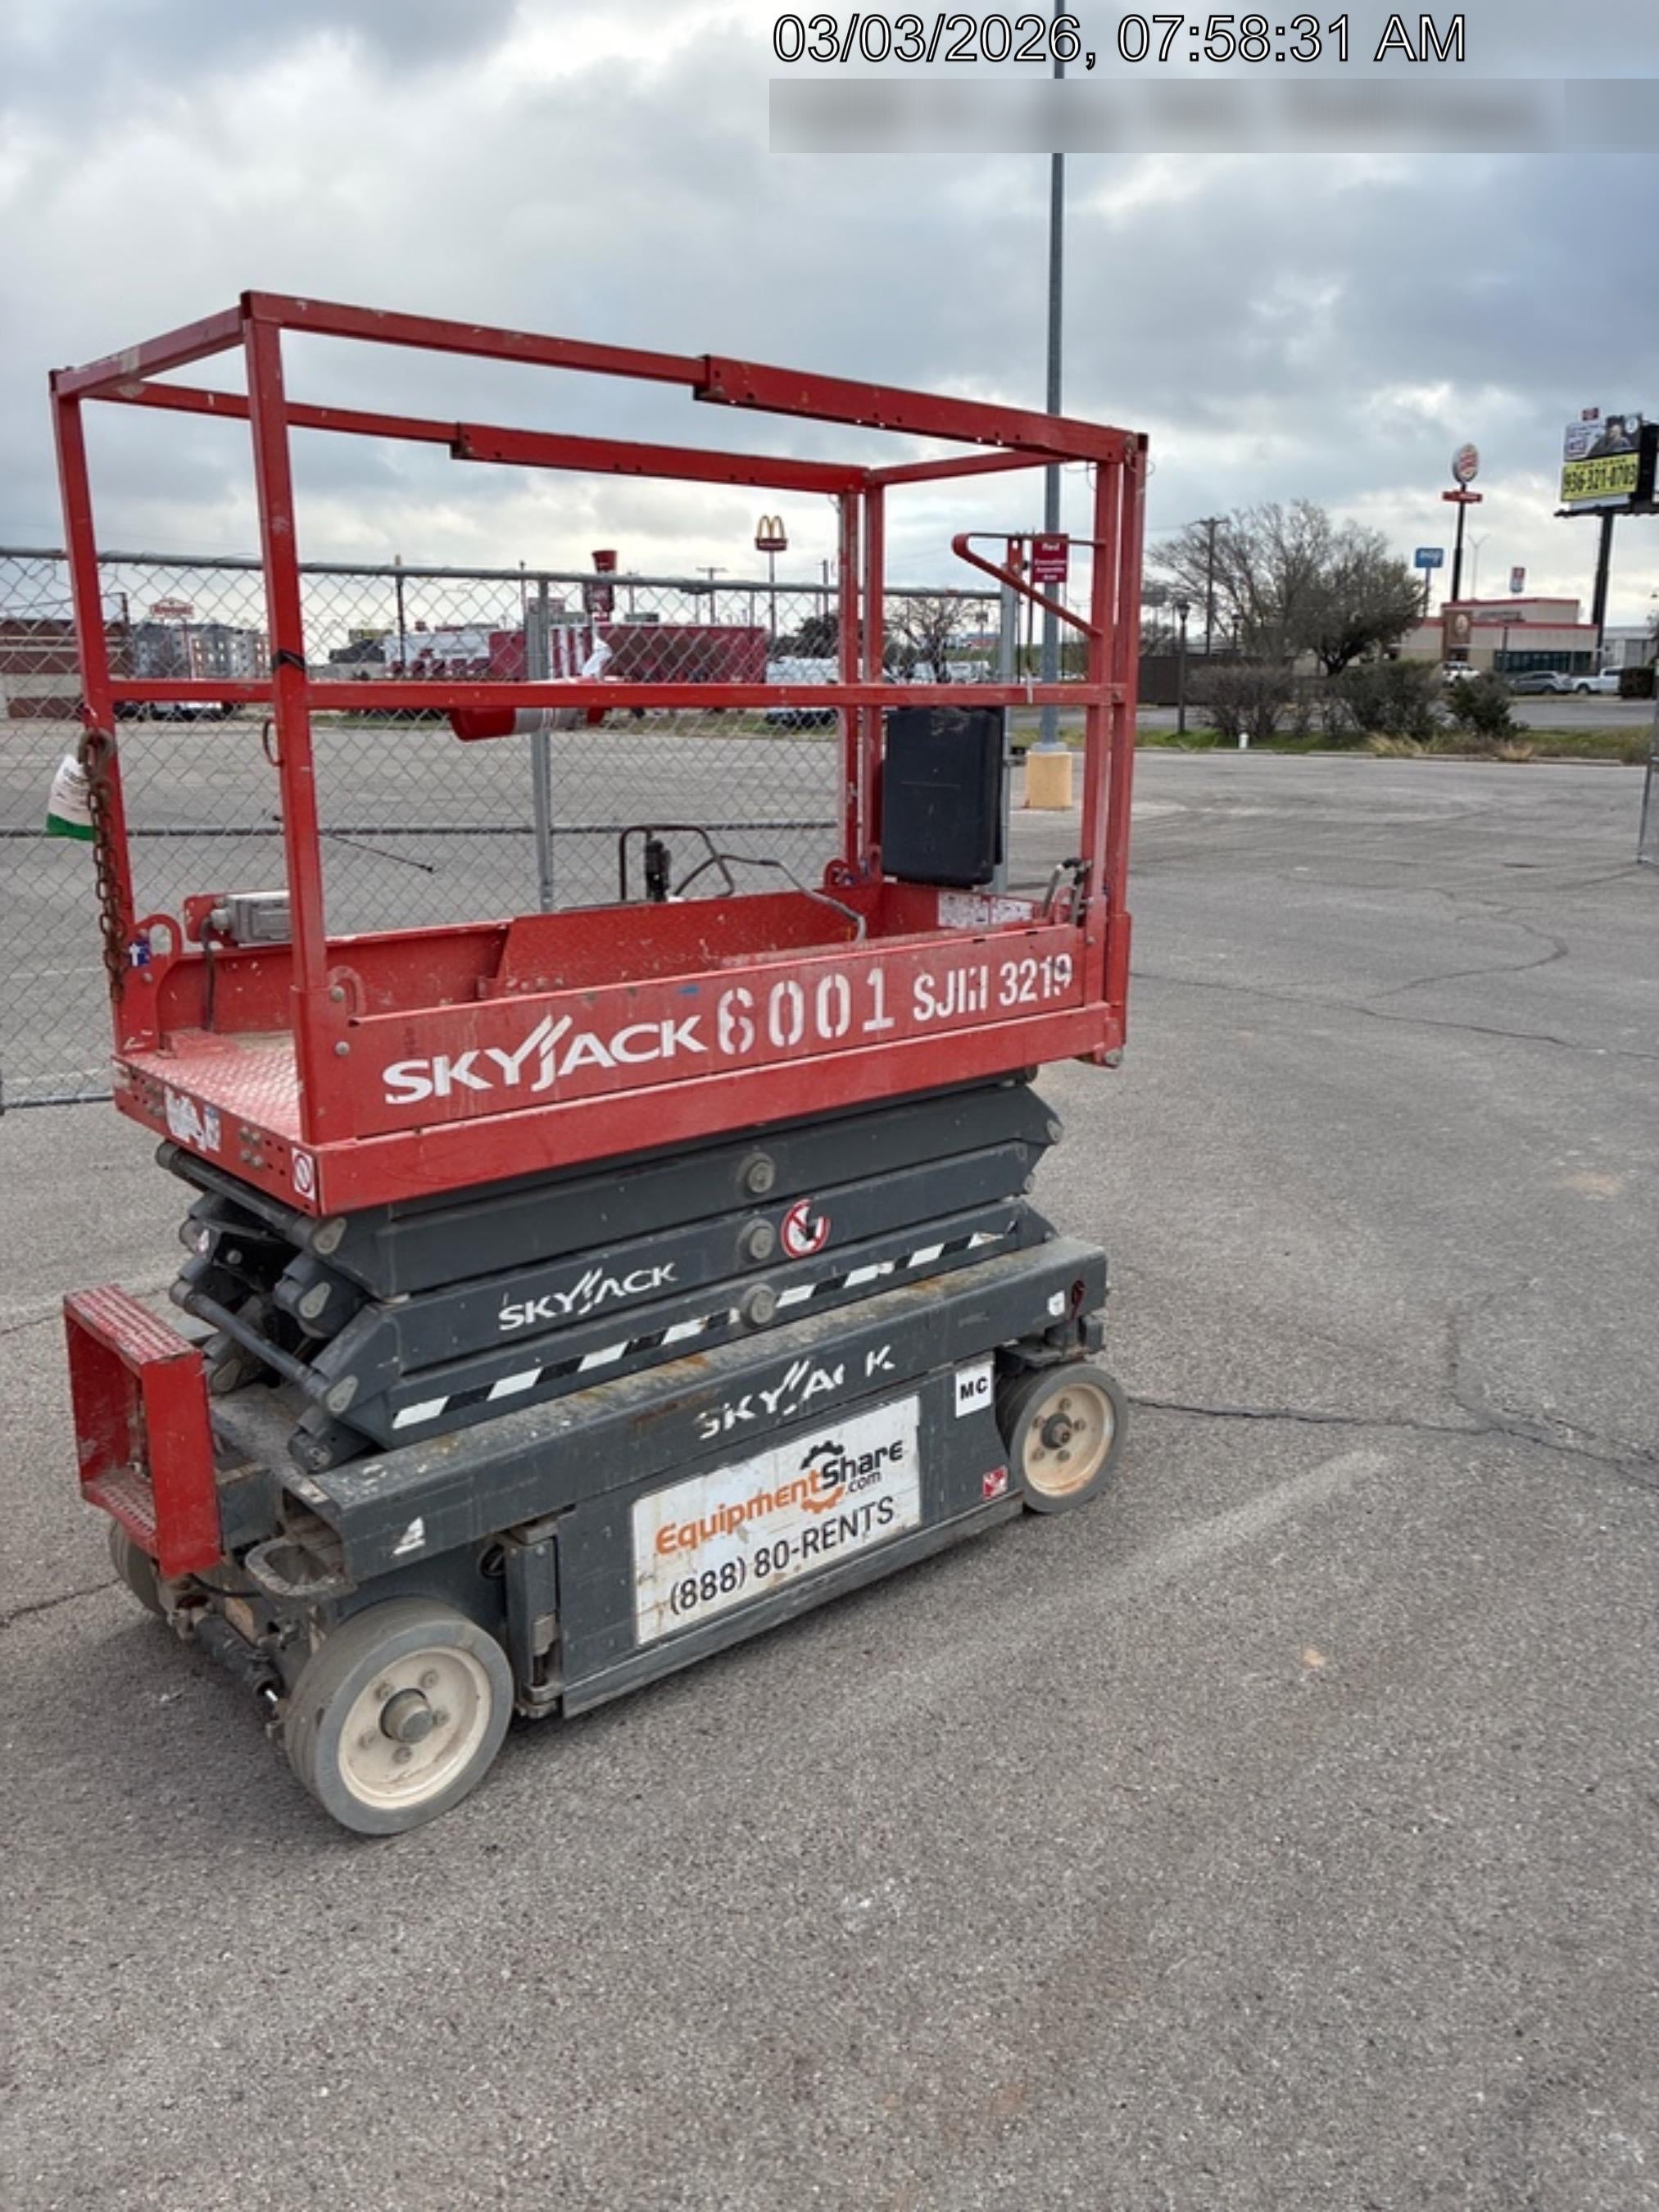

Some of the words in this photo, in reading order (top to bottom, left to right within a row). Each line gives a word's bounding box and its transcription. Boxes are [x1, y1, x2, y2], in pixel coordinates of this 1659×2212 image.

[718, 967, 895, 1055] 6001
[999, 953, 1072, 1006] 3219
[382, 1014, 709, 1104] SKYJACK
[498, 1262, 678, 1330] SKYJACK
[960, 1376, 988, 1400] MC
[655, 1439, 904, 1555] EquipmentShare
[846, 1471, 882, 1495] .com
[669, 1557, 746, 1615] (888)
[754, 1495, 895, 1579] 80-RENTS
